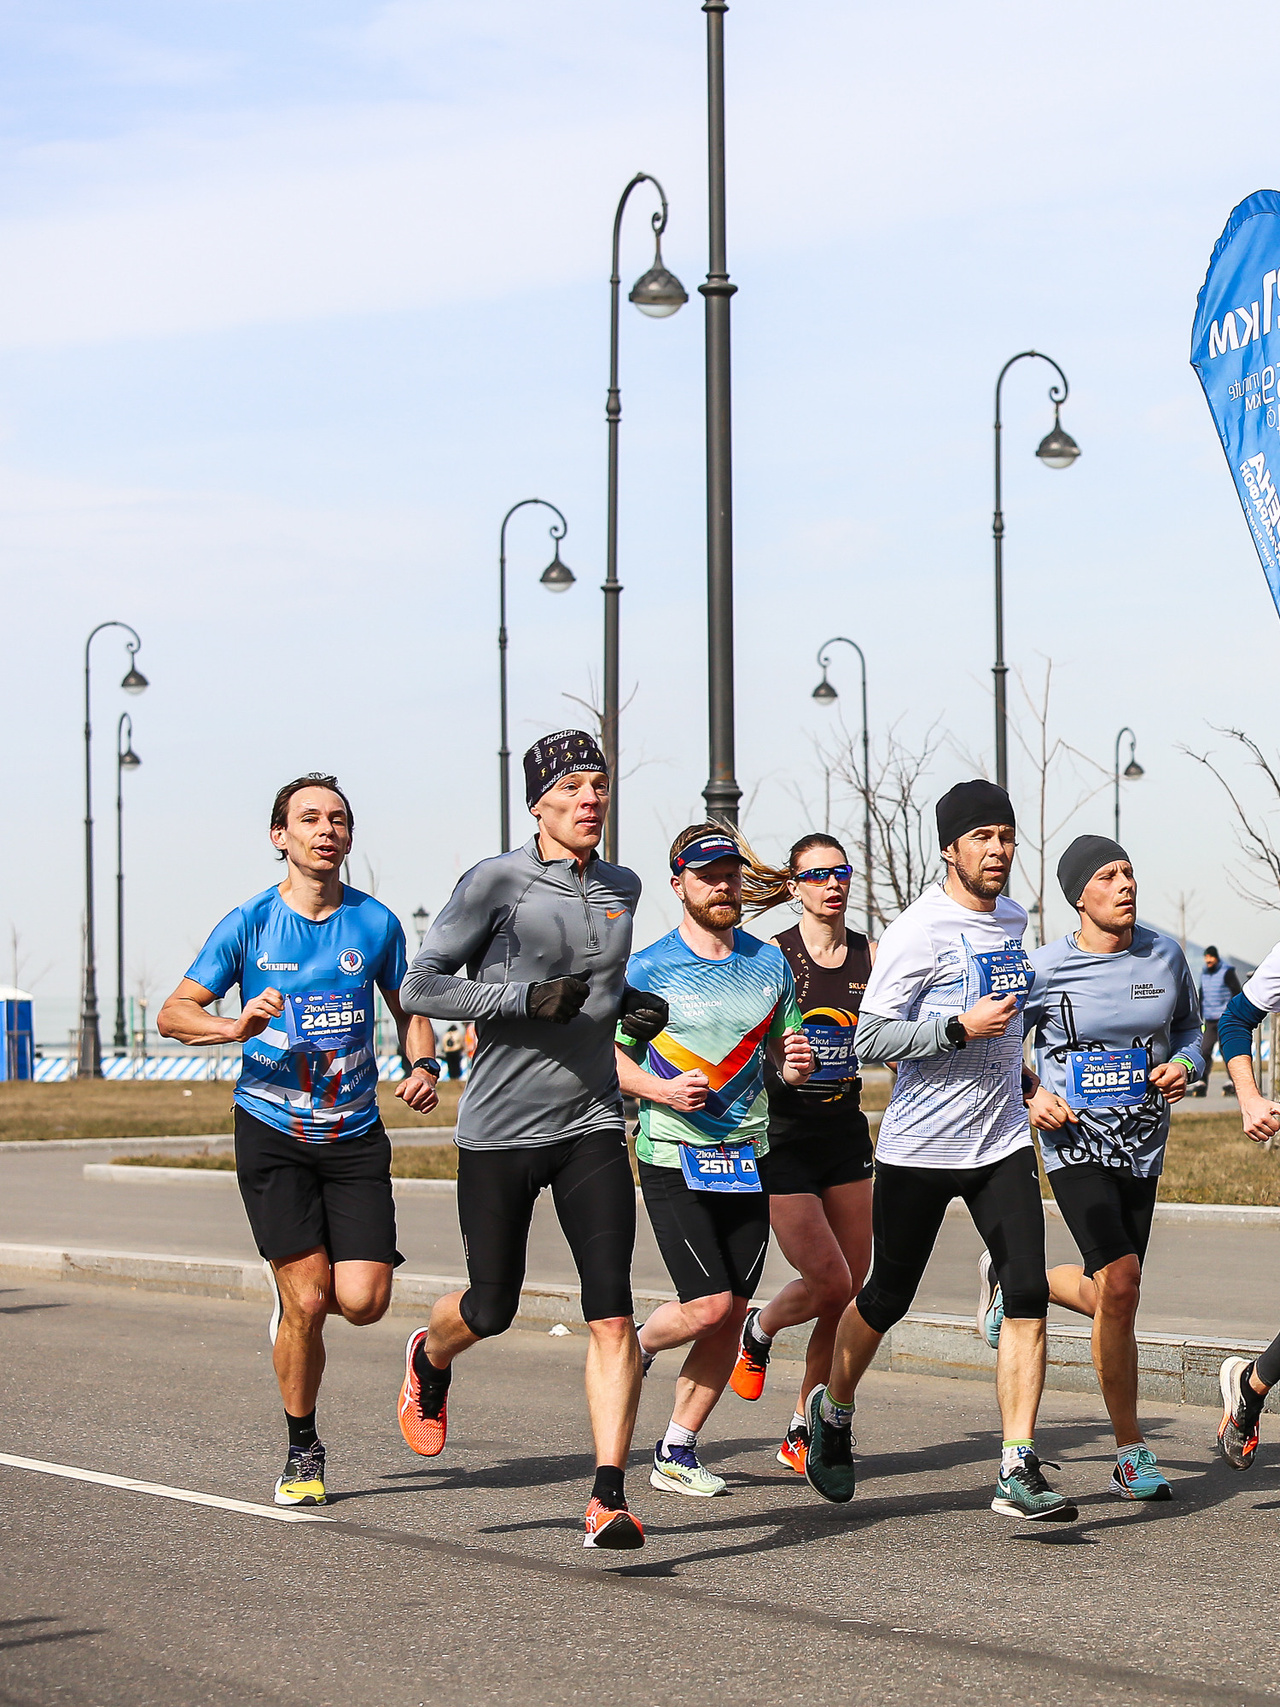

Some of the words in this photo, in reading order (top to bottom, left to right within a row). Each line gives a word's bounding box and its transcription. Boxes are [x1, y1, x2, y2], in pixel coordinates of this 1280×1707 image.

[990, 972, 1028, 991] 2324
[301, 1010, 353, 1030] 2439
[1081, 1070, 1131, 1088] 2082
[699, 1159, 736, 1174] 2511
